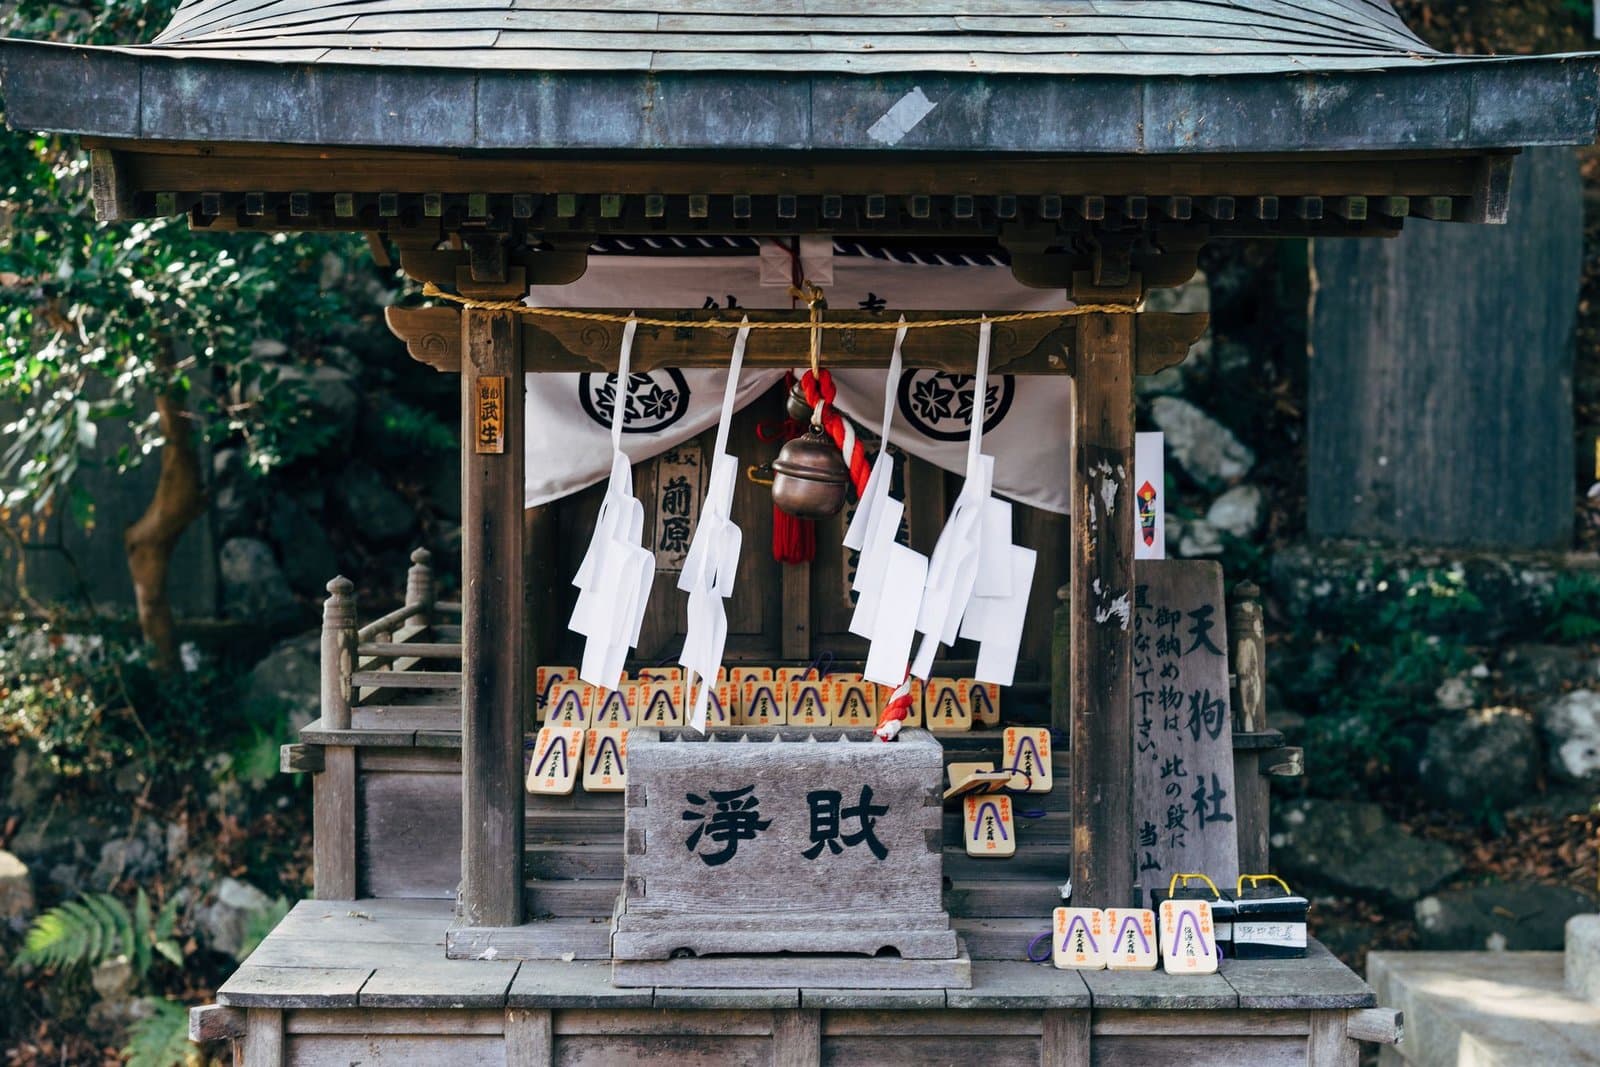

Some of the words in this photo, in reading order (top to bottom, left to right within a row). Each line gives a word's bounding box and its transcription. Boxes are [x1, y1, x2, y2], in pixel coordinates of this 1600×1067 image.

[660, 476, 692, 553] 前原
[1184, 603, 1234, 830] 天狗社
[1138, 820, 1162, 872] 当山
